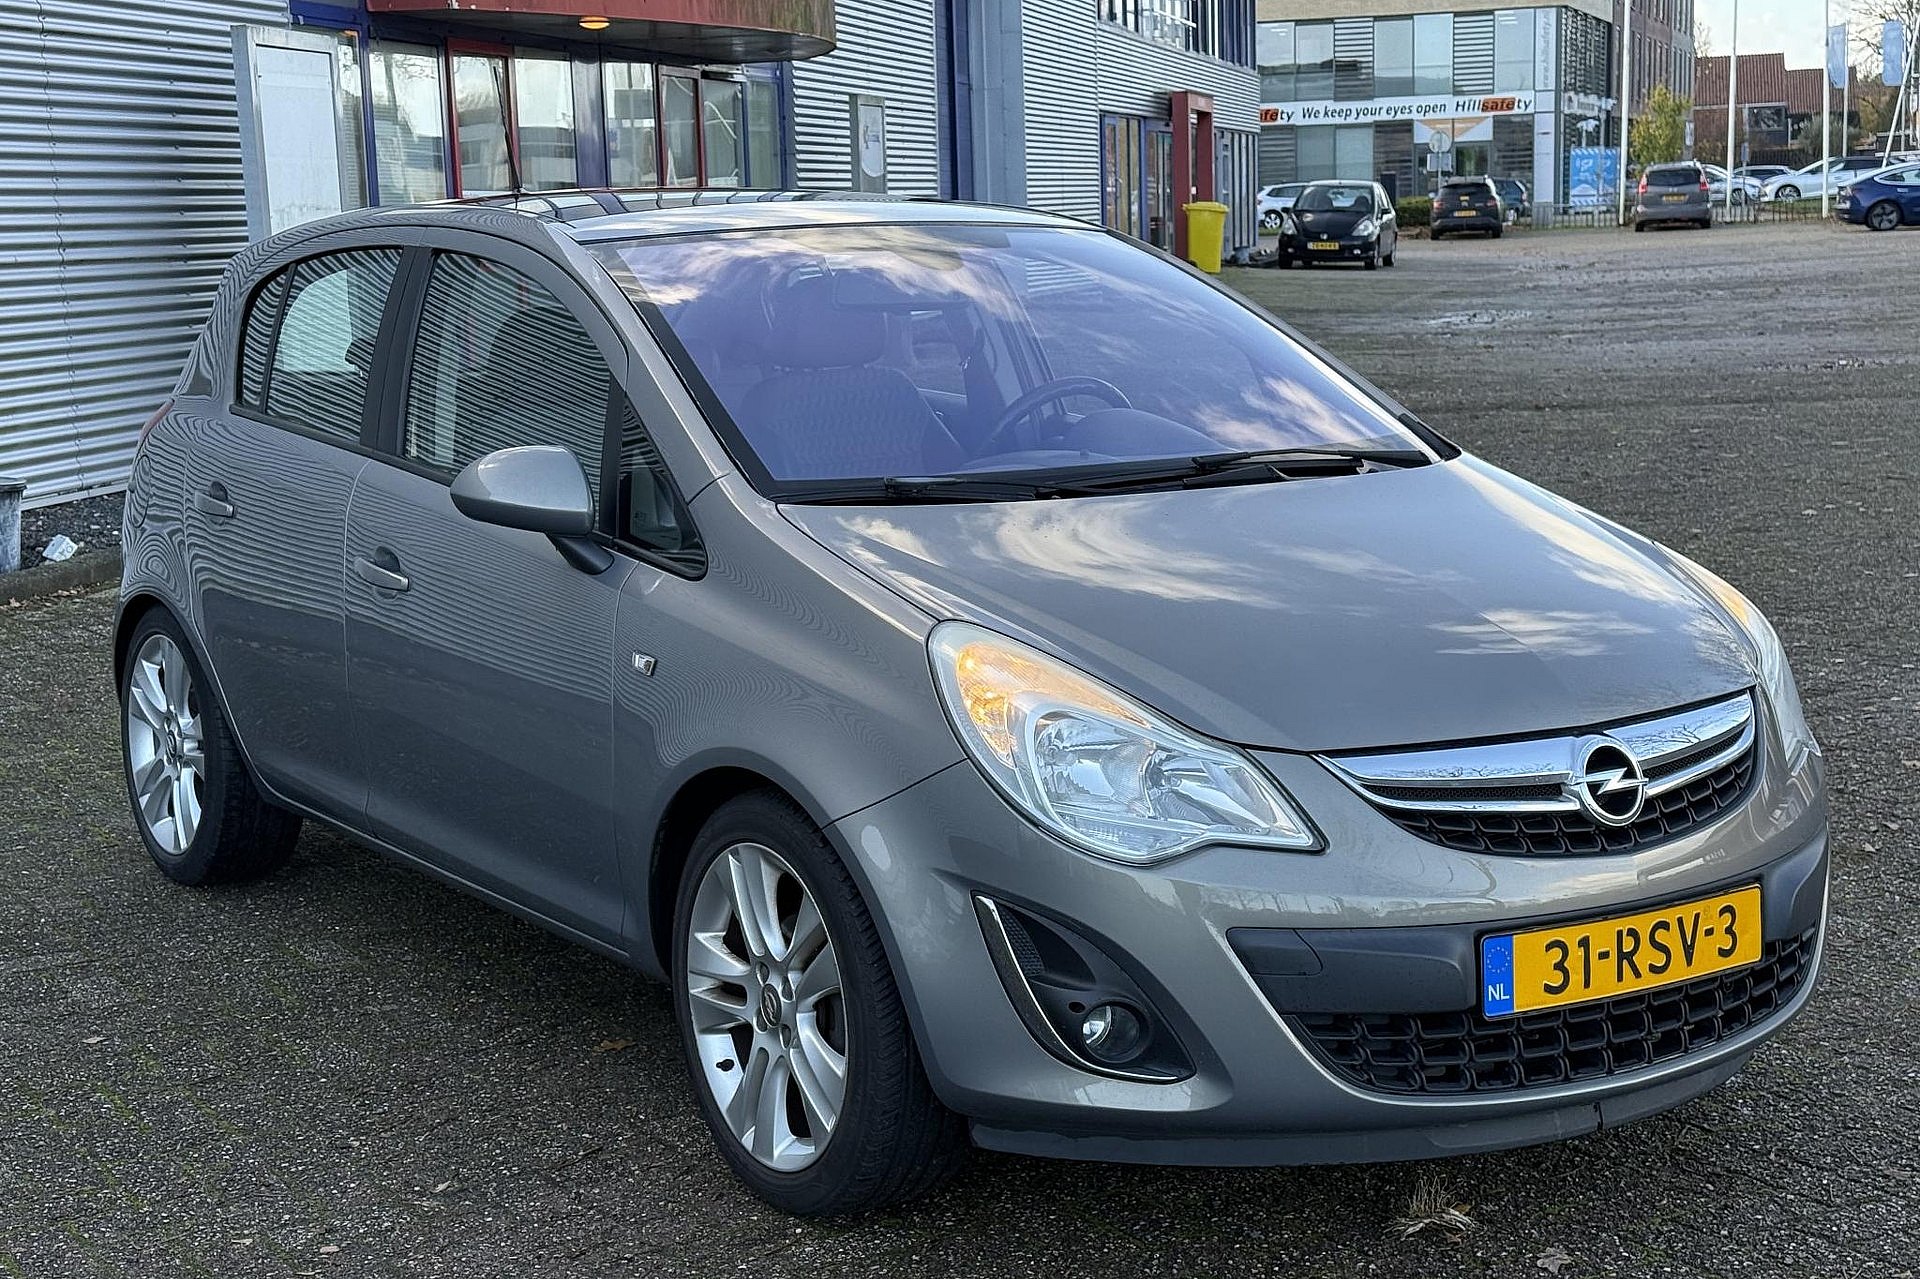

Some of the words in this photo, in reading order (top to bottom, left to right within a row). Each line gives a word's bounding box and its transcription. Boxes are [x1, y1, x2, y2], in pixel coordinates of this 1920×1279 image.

[1302, 107, 1320, 119] We
[1323, 105, 1352, 120] keep
[1355, 106, 1383, 120] your
[1386, 104, 1413, 118] eyes
[1416, 103, 1447, 117] open
[1455, 97, 1532, 113] Hillsafety
[1543, 904, 1738, 995] 31-RSV-3
[1488, 984, 1510, 1001] NL
